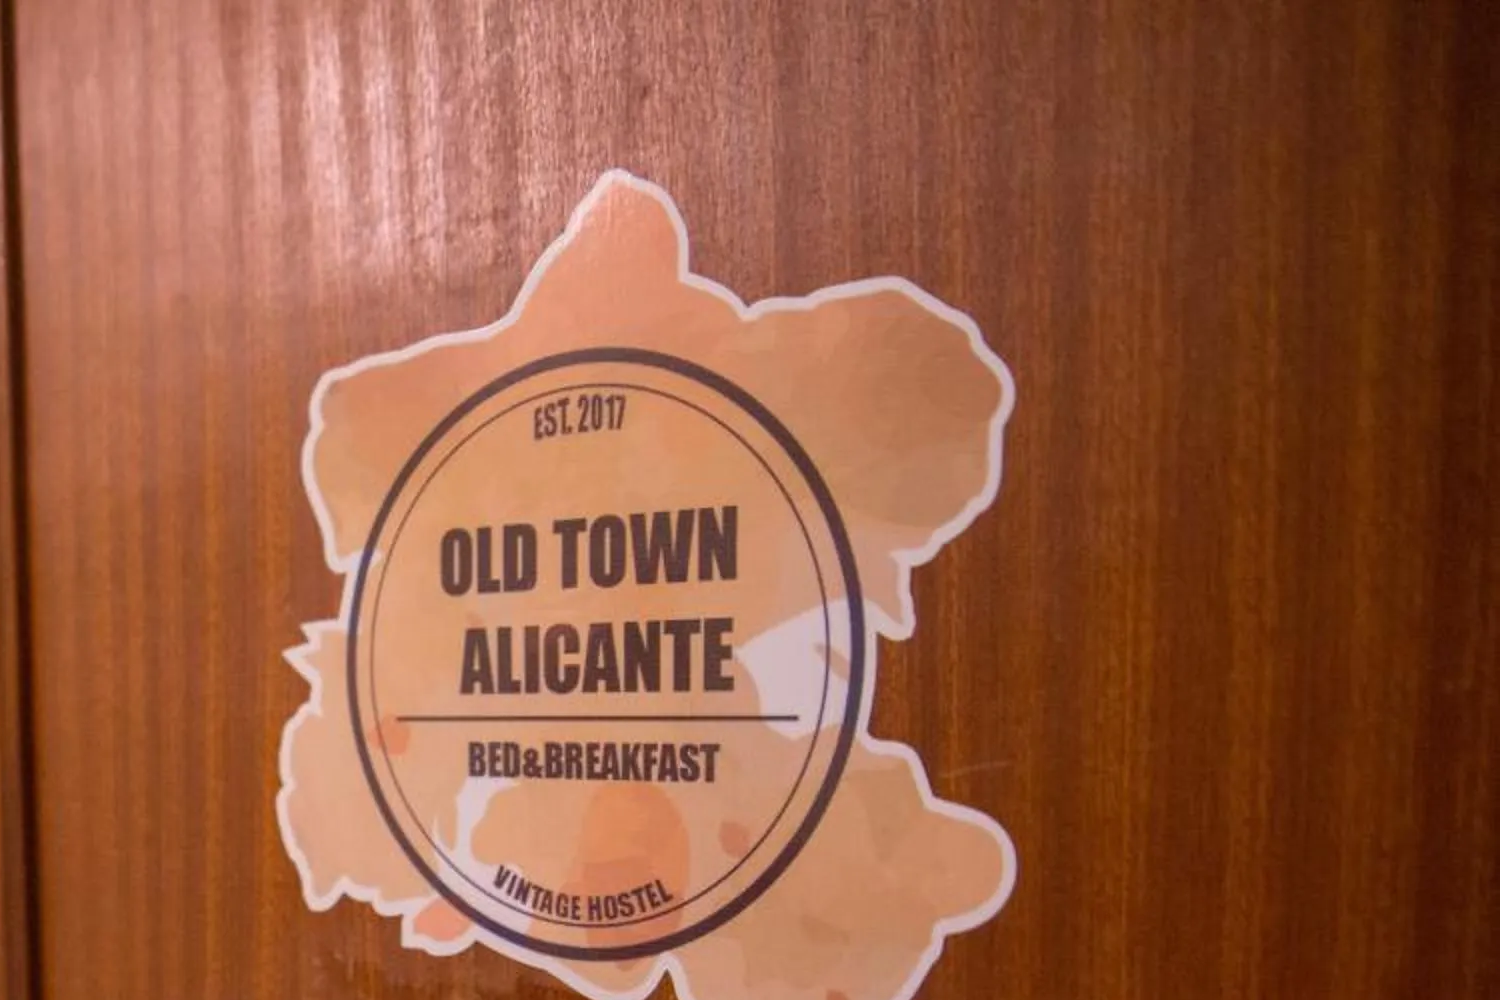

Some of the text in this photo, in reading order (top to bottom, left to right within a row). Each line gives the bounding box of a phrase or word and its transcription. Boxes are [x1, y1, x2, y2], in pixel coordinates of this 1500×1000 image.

[533, 393, 627, 441] EST. 2017
[440, 504, 739, 597] OLD TOWN
[459, 617, 735, 695] ALICANTE
[467, 740, 721, 784] BED&BREAKFAST
[493, 864, 674, 922] VINTAGE HOSTEL
